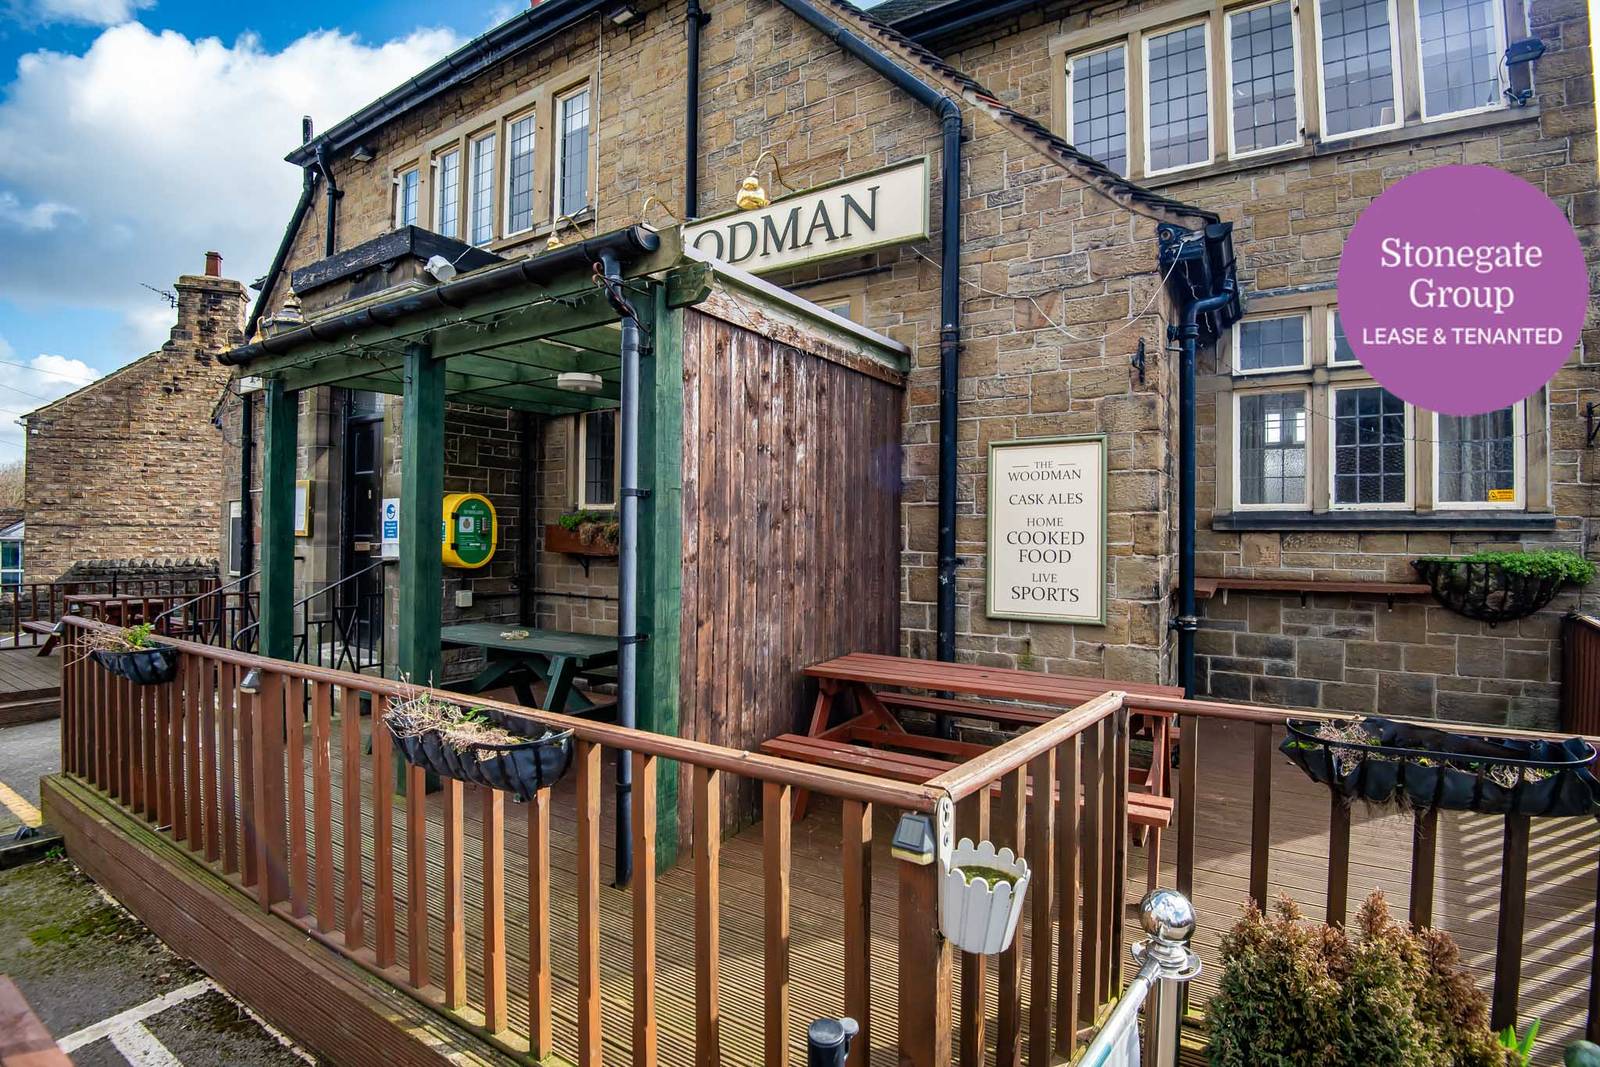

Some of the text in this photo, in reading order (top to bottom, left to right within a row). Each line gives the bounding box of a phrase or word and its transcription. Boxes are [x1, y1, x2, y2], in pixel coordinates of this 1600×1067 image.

[1034, 460, 1054, 469] THE
[1008, 469, 1082, 482] WOODMAN
[1009, 492, 1083, 506] CASK ALES
[1027, 517, 1064, 527] HOME
[1006, 530, 1085, 546] COOKED
[1019, 548, 1072, 564] FOOD
[1032, 573, 1058, 584] LIVE
[1011, 585, 1080, 603] SPORTS
